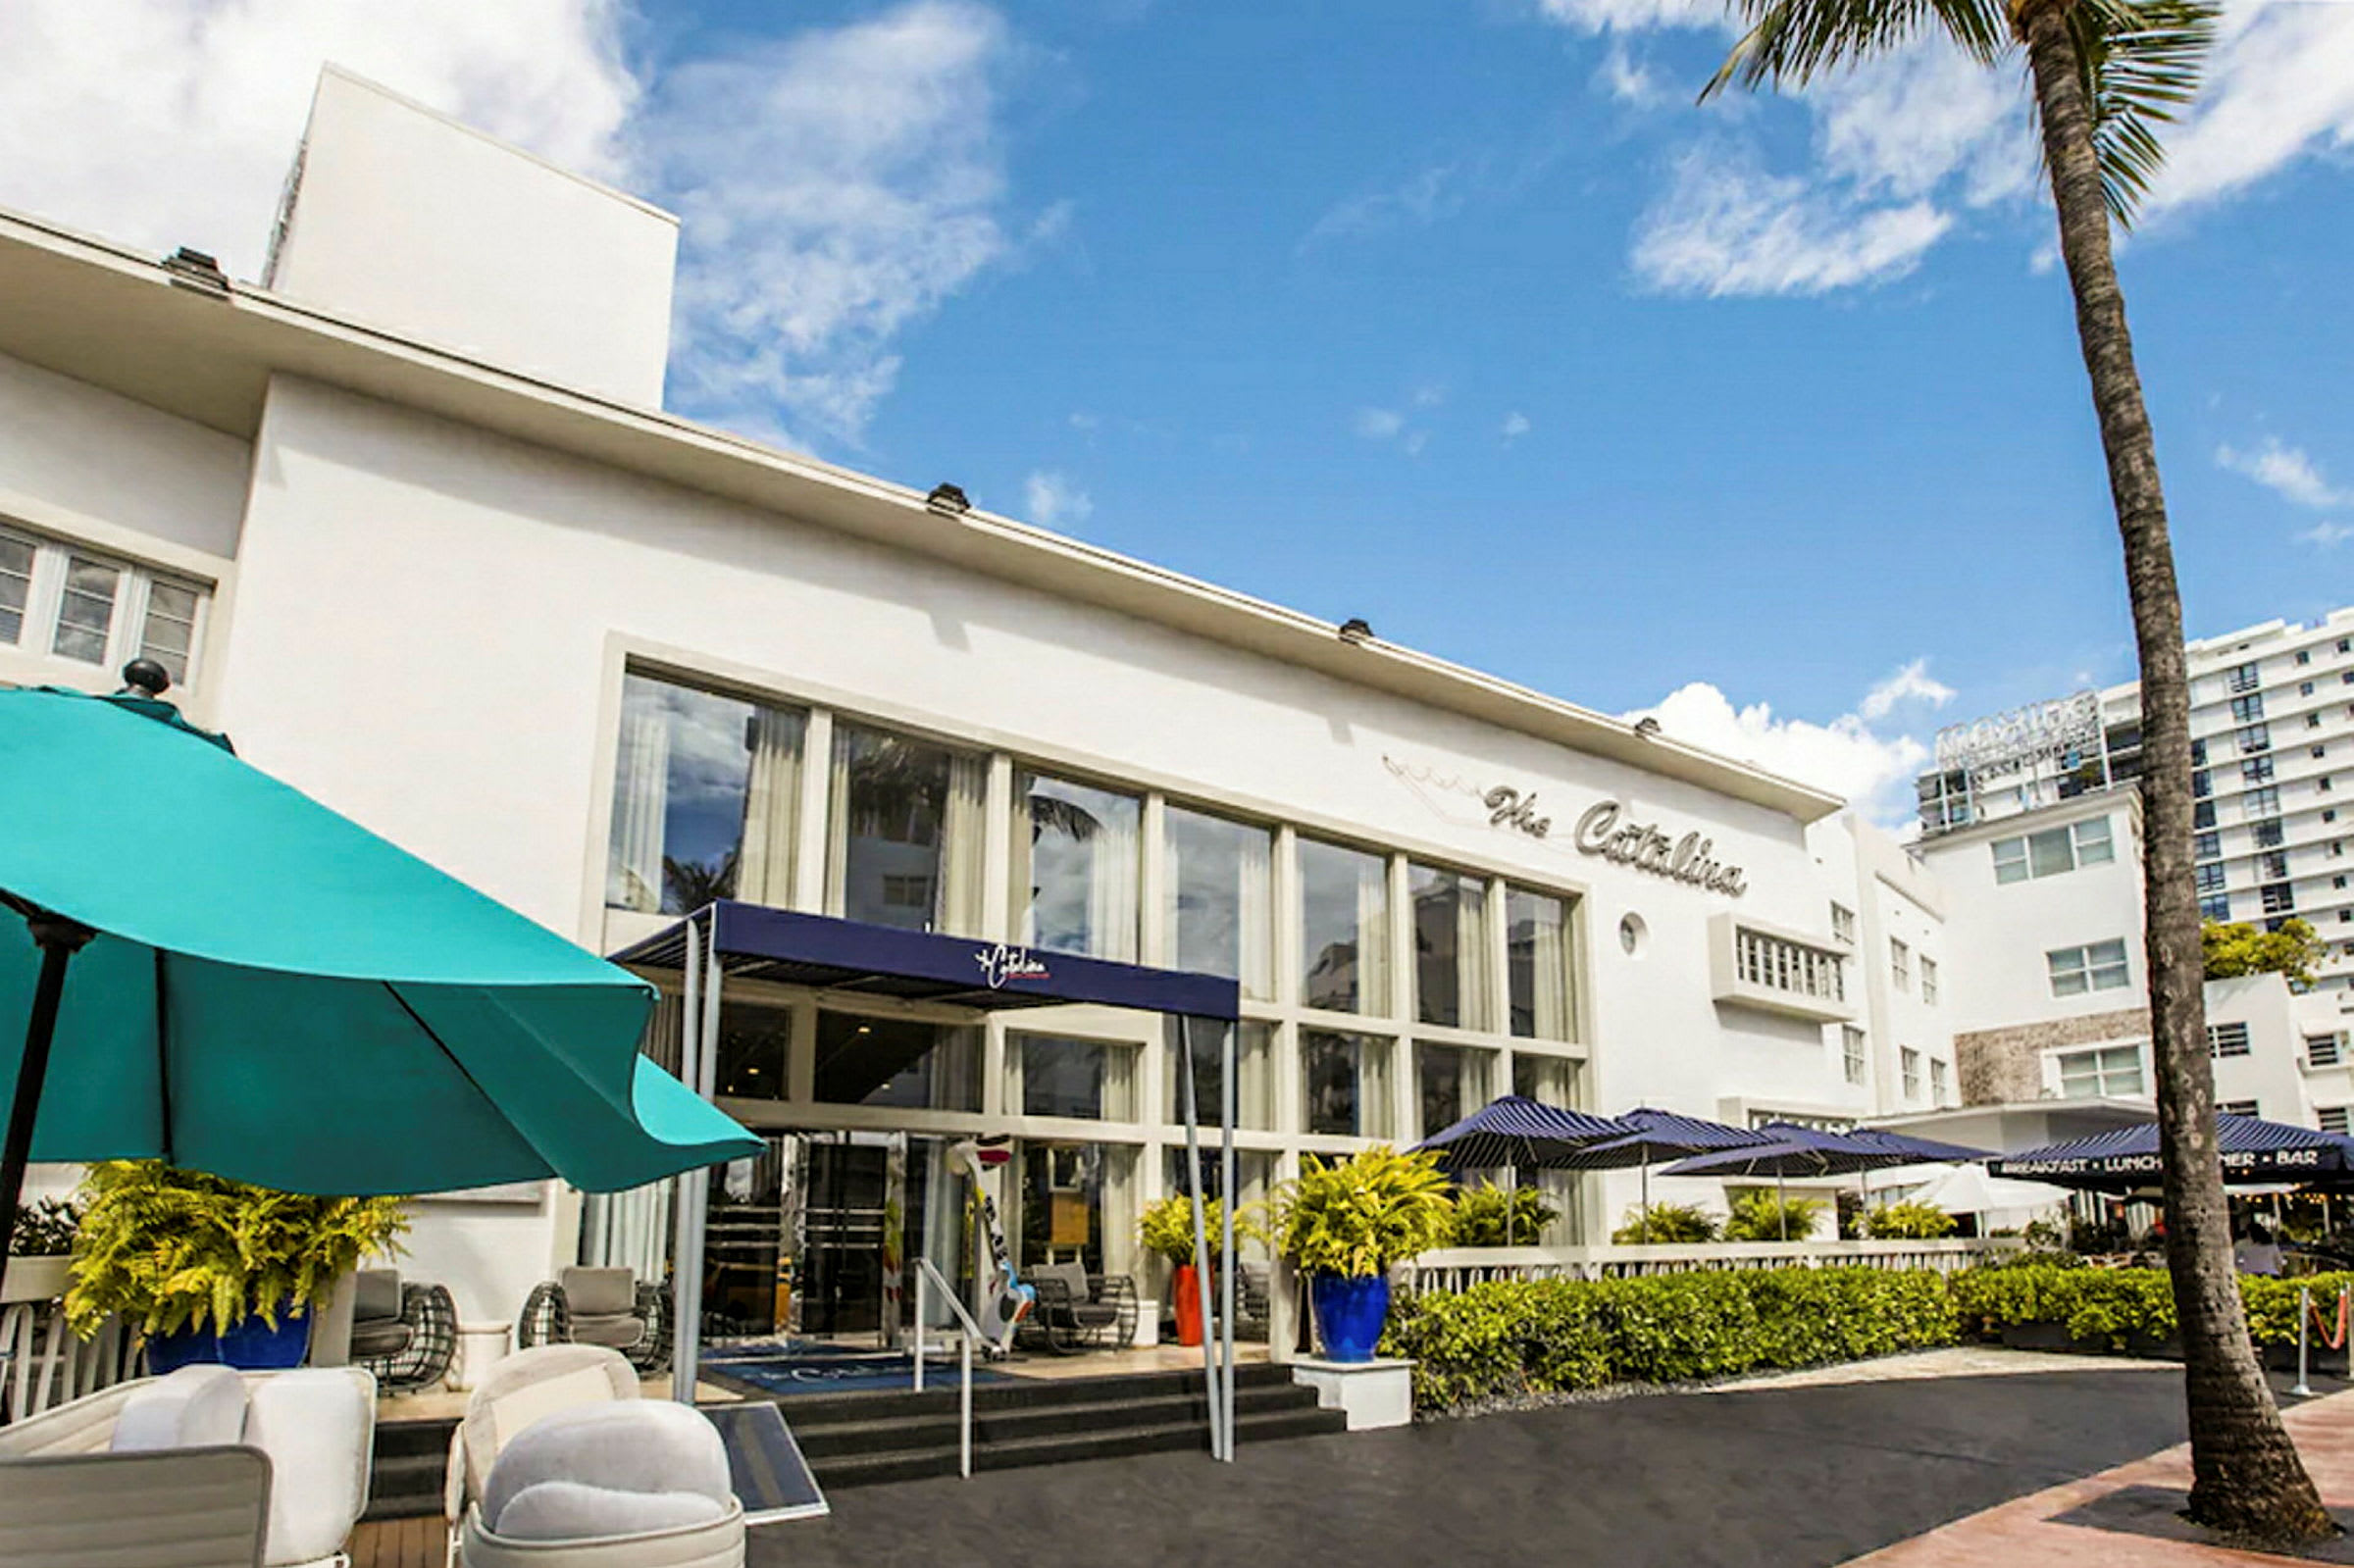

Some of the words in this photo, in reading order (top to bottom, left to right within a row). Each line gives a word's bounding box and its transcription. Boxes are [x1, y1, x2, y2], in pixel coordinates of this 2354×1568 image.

[1484, 785, 1551, 837] The
[1575, 800, 1747, 896] Catalina
[2001, 1159, 2087, 1175] BREAKFAST
[2105, 1154, 2163, 1172] LUNCH
[2277, 1150, 2319, 1165] BAR
